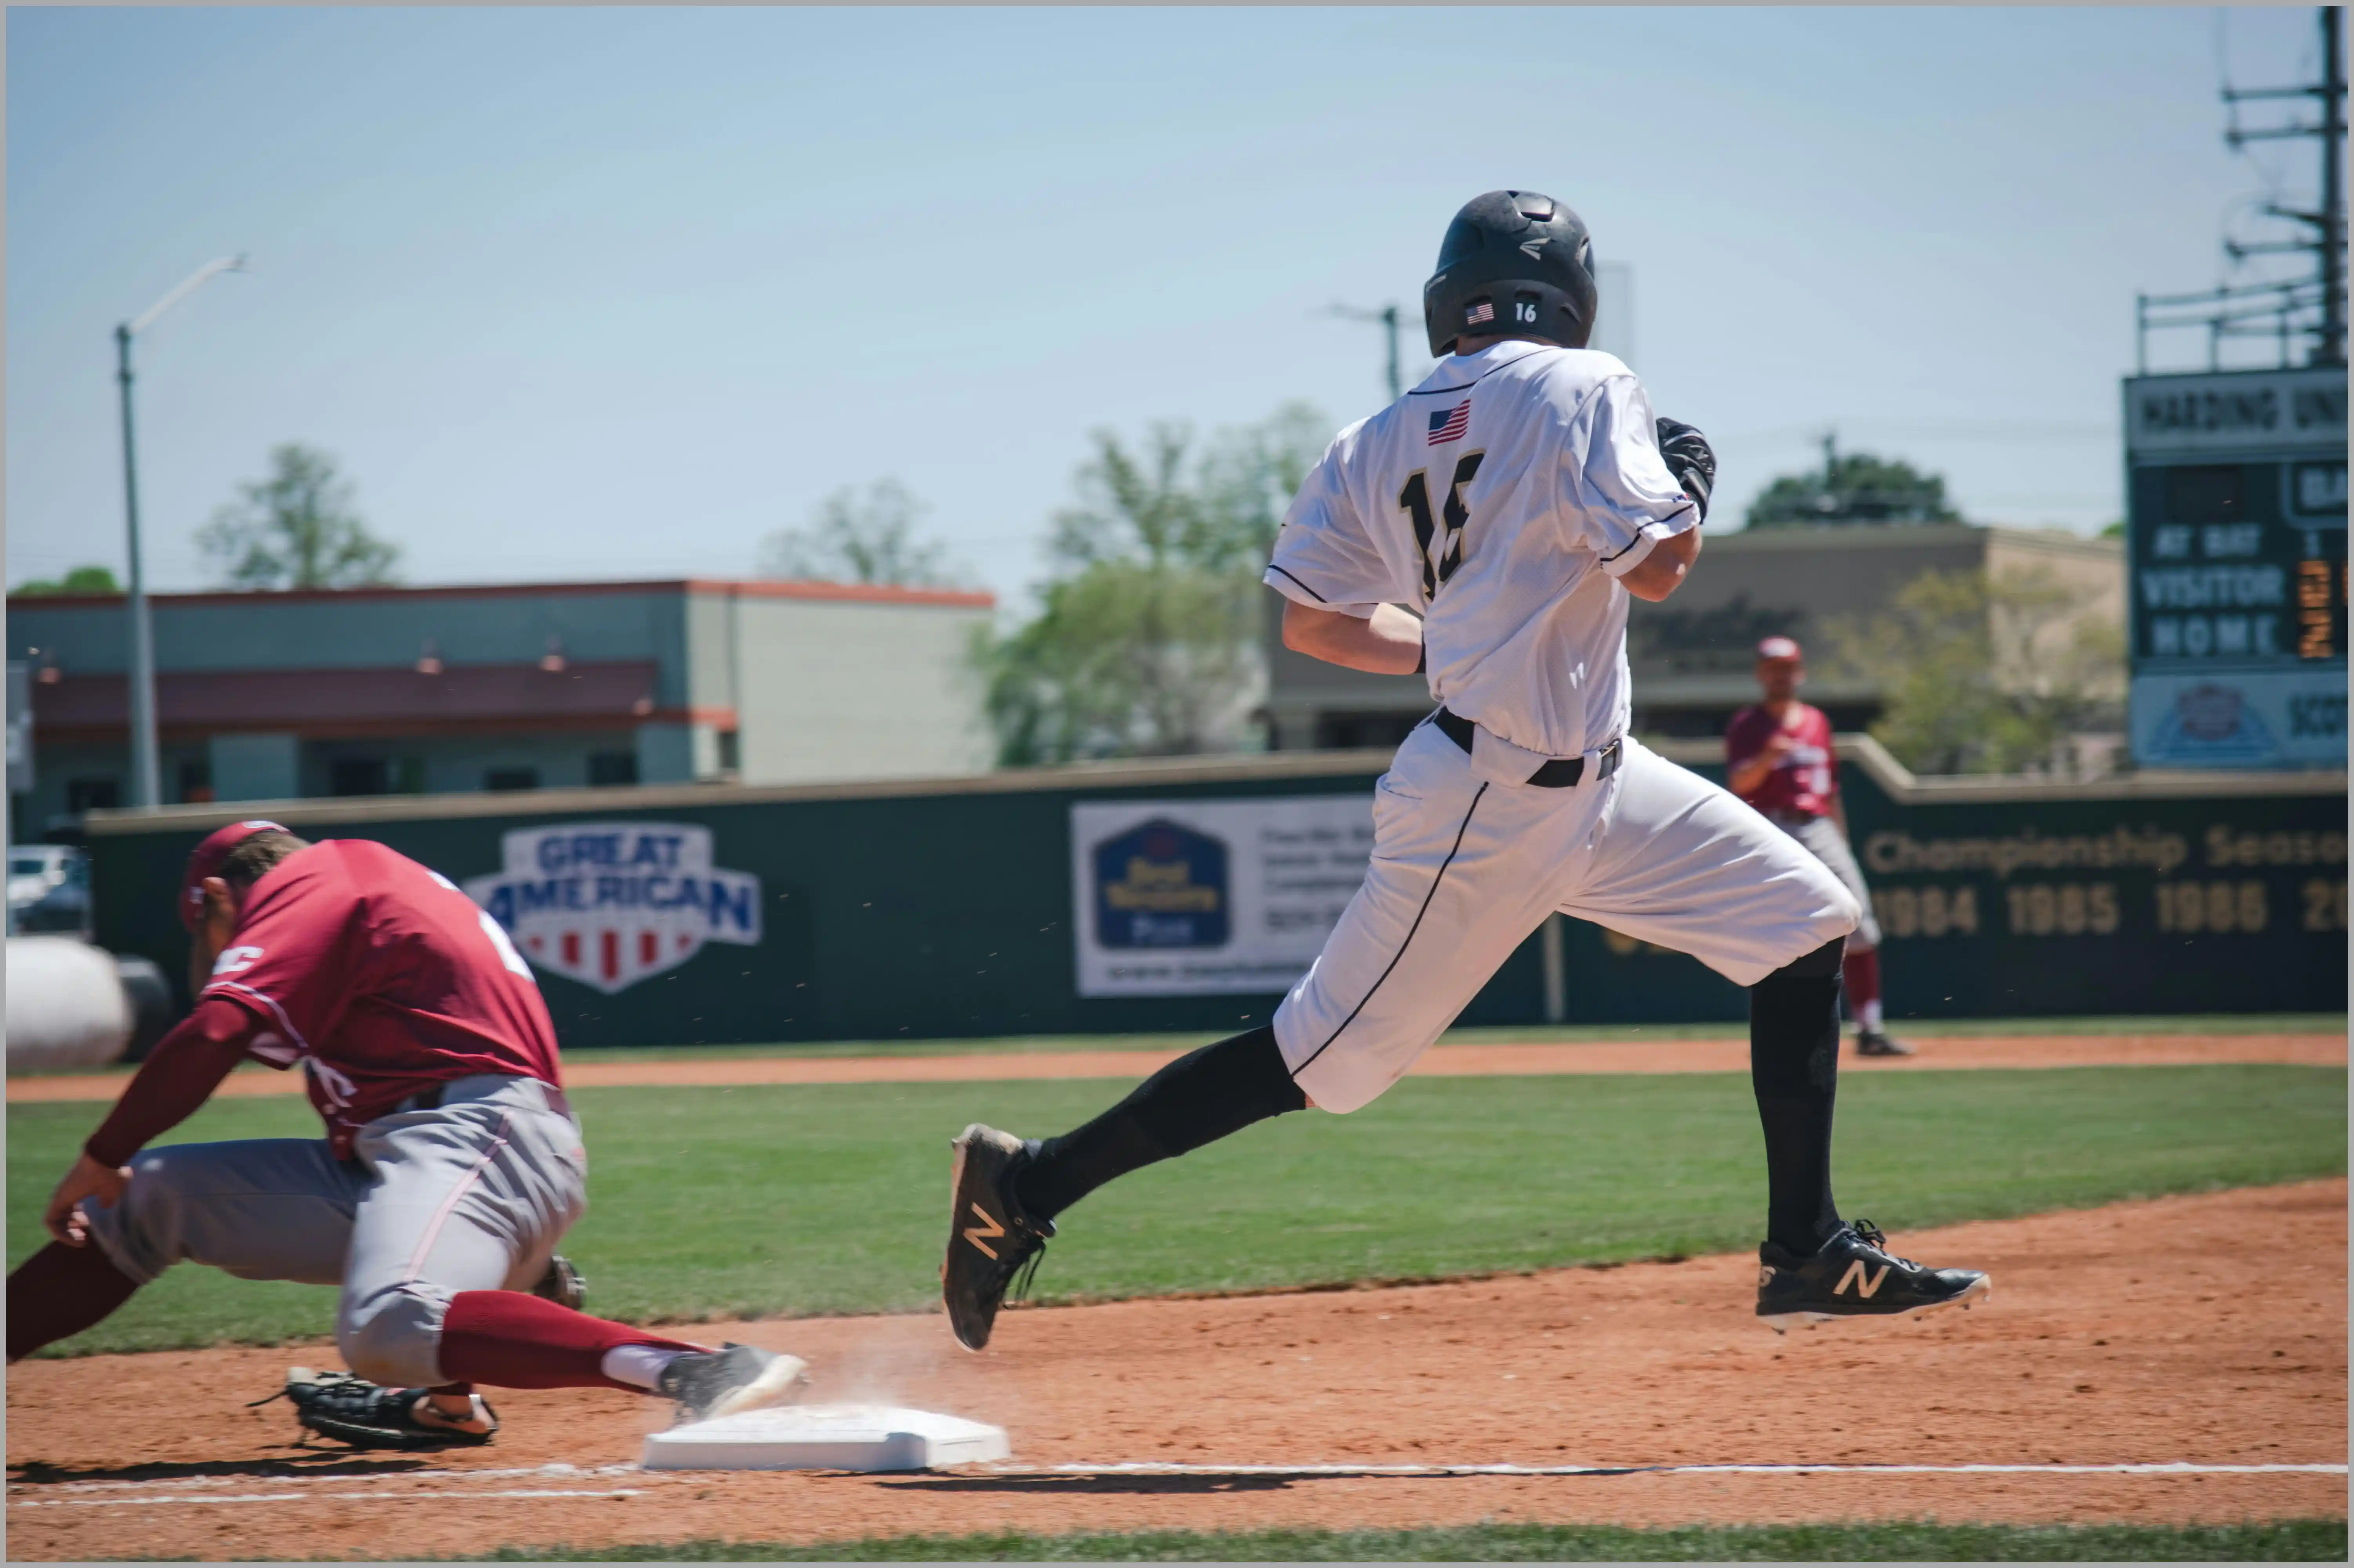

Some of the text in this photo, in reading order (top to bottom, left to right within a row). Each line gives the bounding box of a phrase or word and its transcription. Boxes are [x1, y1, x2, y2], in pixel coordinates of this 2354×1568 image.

[1515, 302, 1537, 323] 16
[2142, 387, 2280, 432] HARDING
[2153, 522, 2262, 558] AT BAT
[2141, 565, 2284, 609] VISITOR
[2151, 614, 2277, 656] HOME
[537, 834, 683, 869] GREAT
[1867, 824, 2186, 881] Championship
[487, 876, 753, 931] AMERICAN
[2008, 882, 2120, 936] 1985
[1832, 1259, 1891, 1299] N
